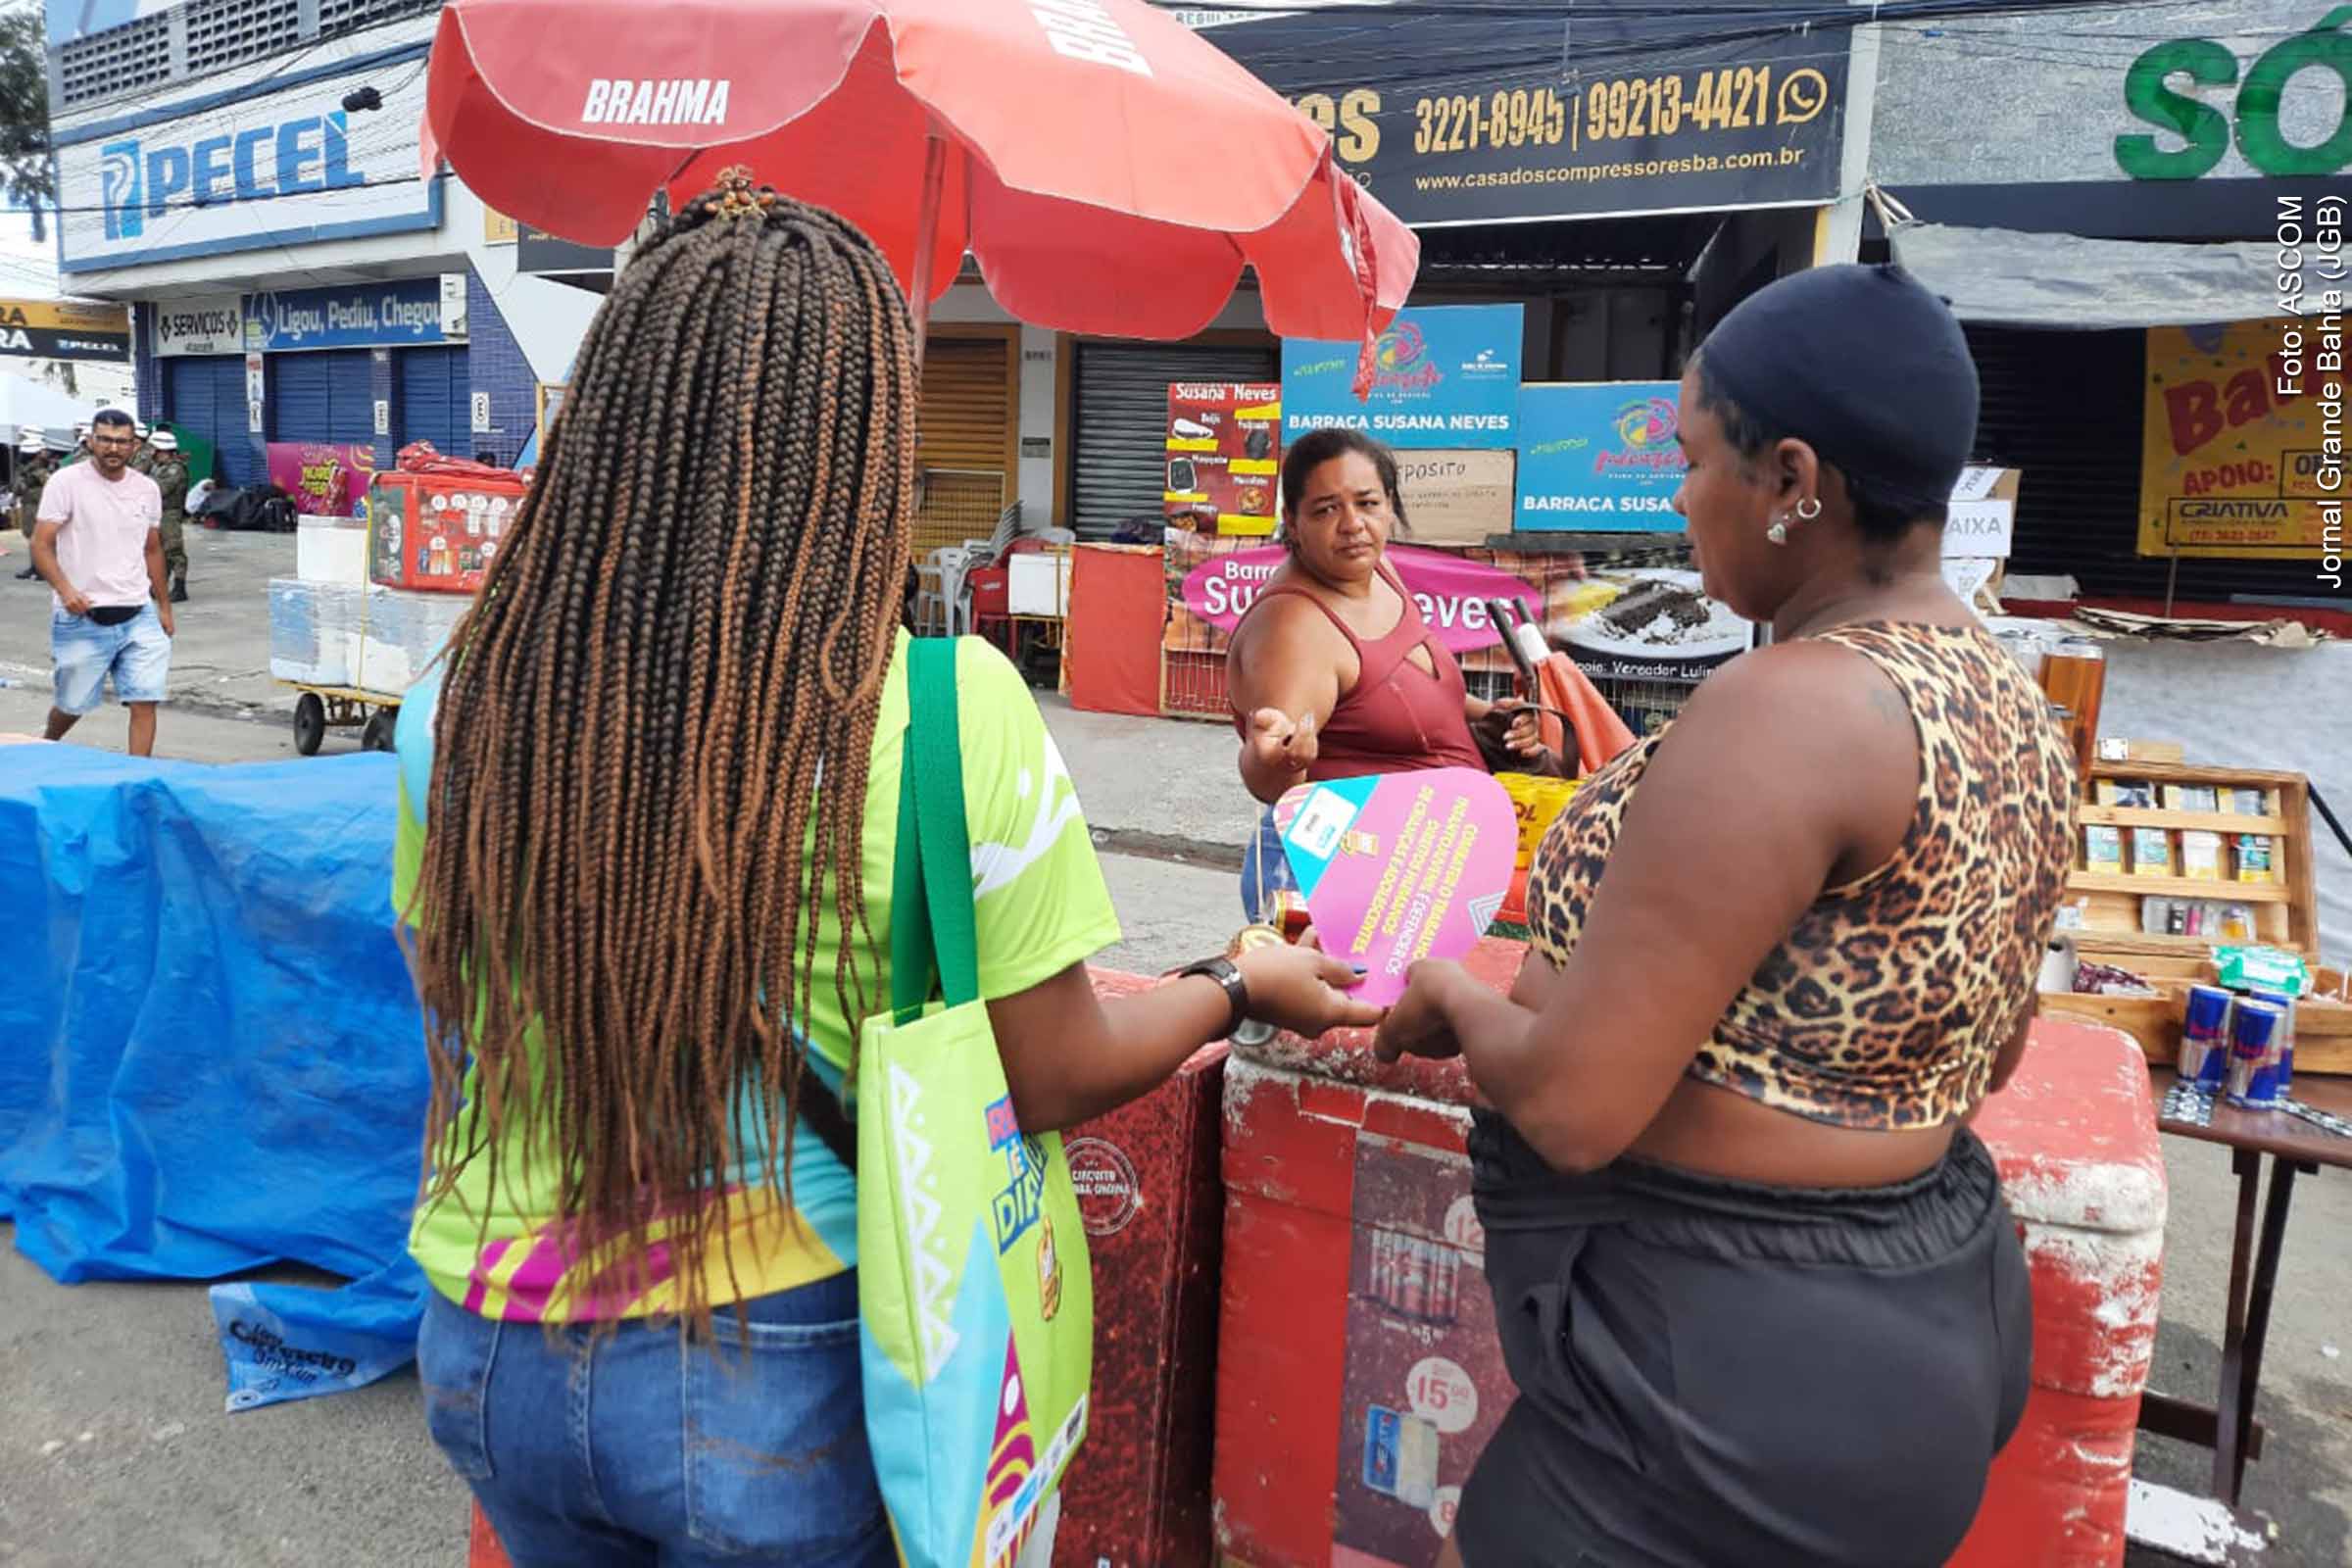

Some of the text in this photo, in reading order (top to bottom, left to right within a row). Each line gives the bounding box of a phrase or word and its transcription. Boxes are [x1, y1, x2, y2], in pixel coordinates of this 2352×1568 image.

[581, 78, 730, 124] BRAHMA
[1414, 66, 1770, 154] 3221-8945 99213-4421
[1296, 88, 1381, 163] es
[147, 110, 365, 219] PECEL
[1414, 147, 1804, 191] www.casadoscompressoresba.com.br
[173, 311, 225, 339] SERVIÇOS
[279, 306, 324, 340] Ligou,
[328, 301, 378, 332] Pediu,
[1176, 382, 1276, 401] Susana Neves
[1289, 415, 1510, 430] BARRACA SUSANA NEVES
[2182, 459, 2275, 496] APOIO:
[1523, 496, 1672, 512] BARRACA SUSA
[2180, 502, 2288, 518] CRIATIVA
[1949, 516, 2002, 534] AIXA
[1412, 593, 1513, 630] eves
[1612, 661, 1677, 676] Vereador
